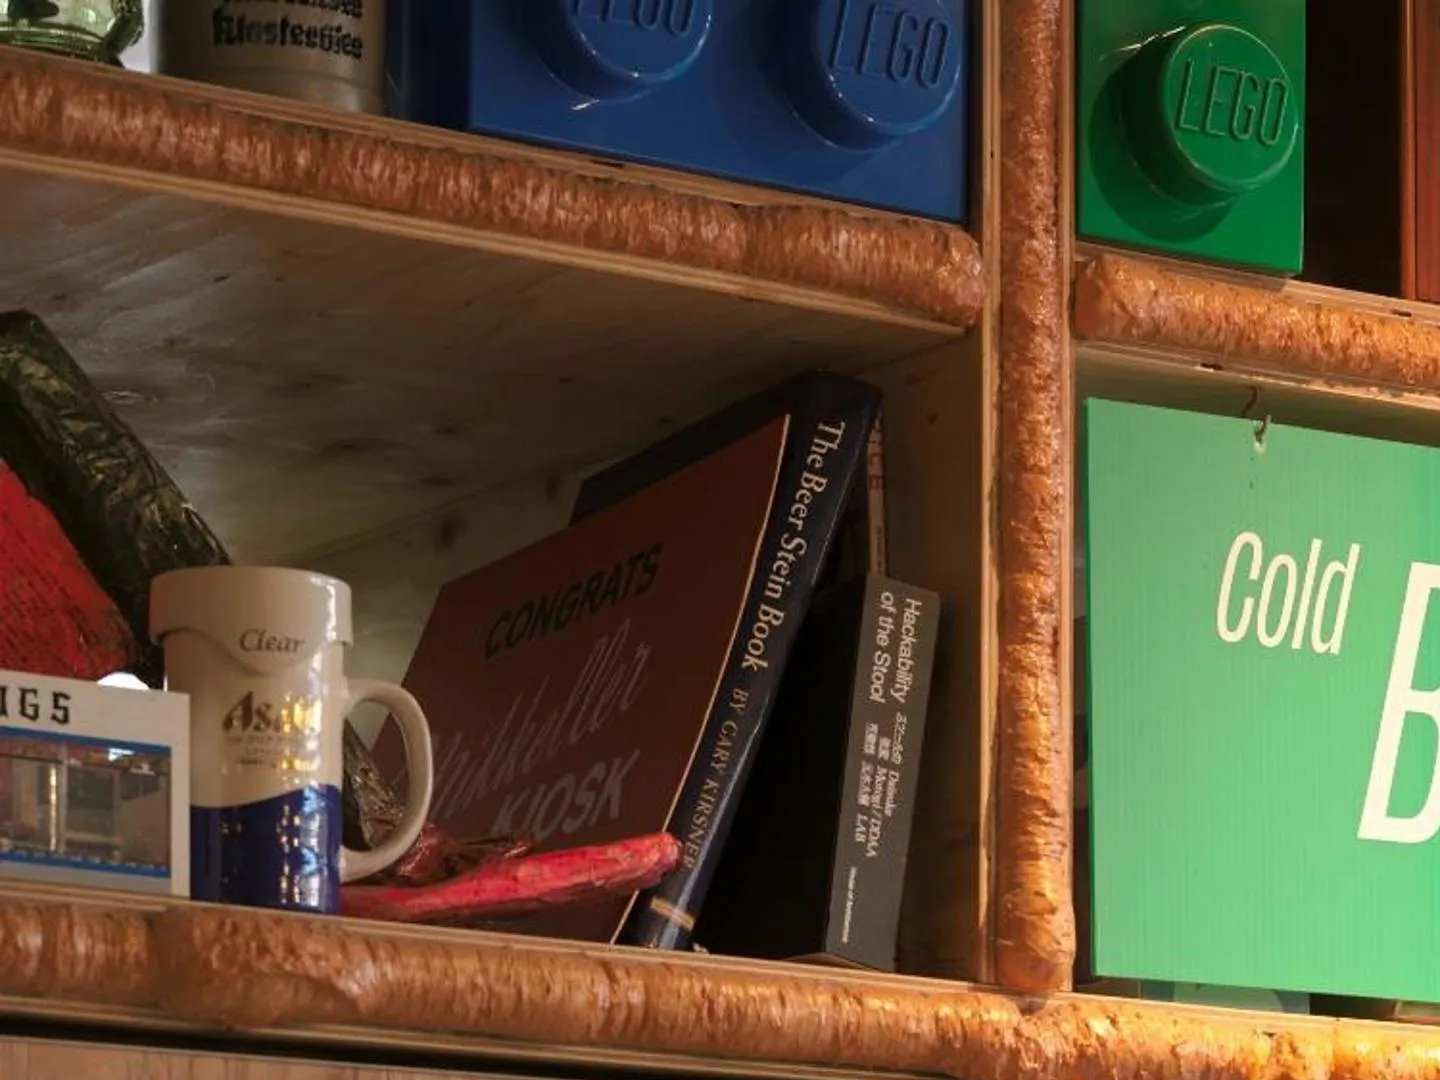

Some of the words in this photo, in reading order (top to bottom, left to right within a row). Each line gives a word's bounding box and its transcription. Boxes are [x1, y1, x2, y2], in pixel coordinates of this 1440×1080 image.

[828, 0, 950, 88] LEGO
[1174, 58, 1290, 147] LEGO
[805, 421, 846, 468] The
[788, 472, 829, 531] Beer
[764, 533, 808, 599] Stein
[1216, 531, 1361, 656] Cold
[484, 542, 664, 660] CONGRATS
[876, 616, 896, 646] the
[881, 591, 897, 614] of
[239, 628, 305, 654] Clear
[741, 604, 785, 672] Book
[890, 598, 922, 703] Hackability
[729, 688, 750, 715] BY
[869, 651, 891, 704] Stool
[711, 720, 739, 775] GARY
[490, 748, 641, 841] KIOSK
